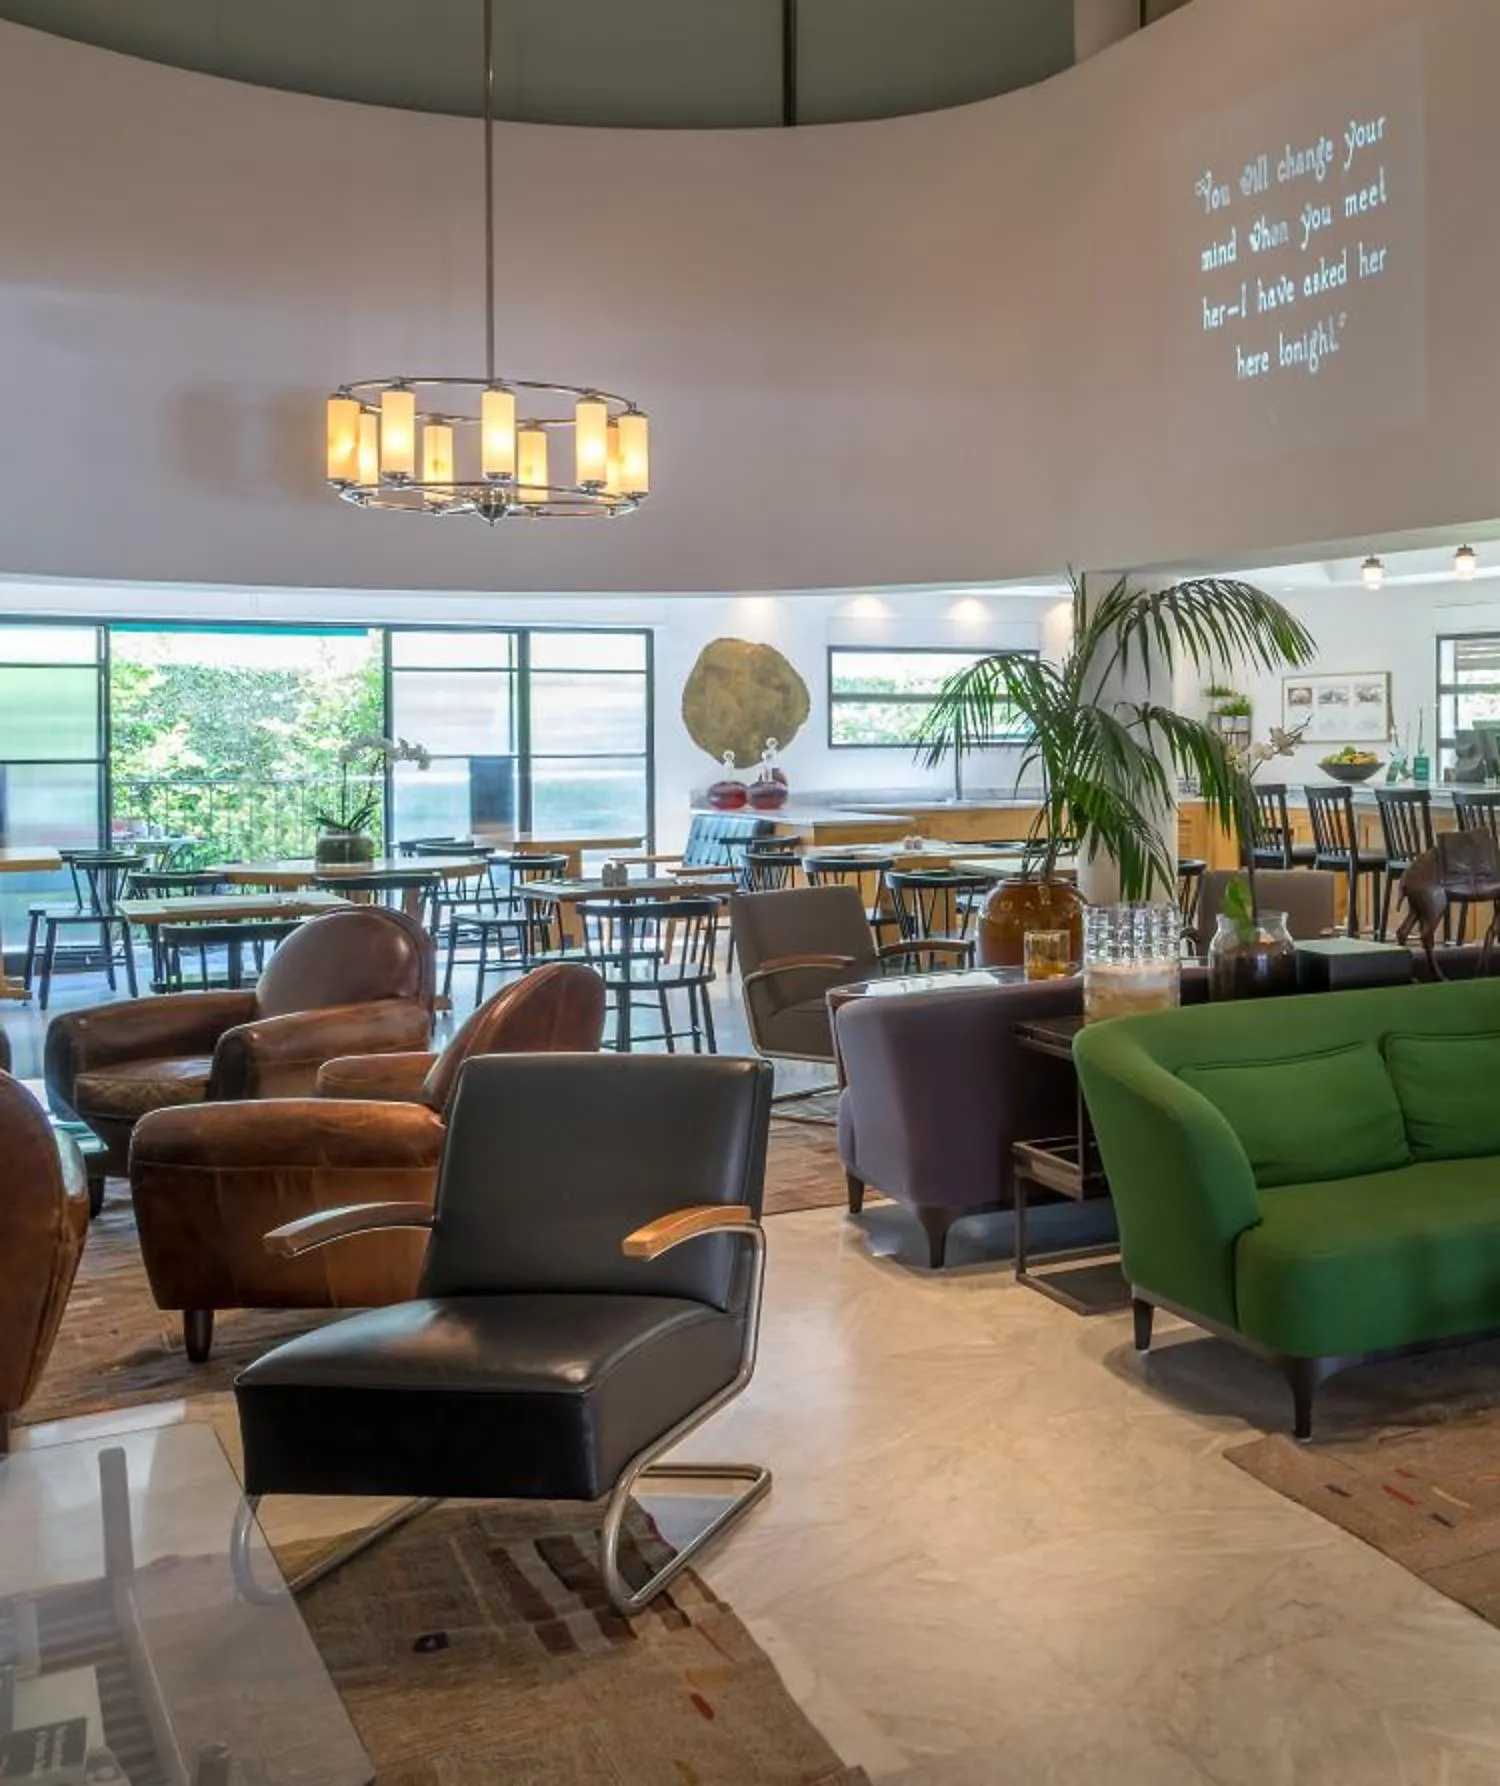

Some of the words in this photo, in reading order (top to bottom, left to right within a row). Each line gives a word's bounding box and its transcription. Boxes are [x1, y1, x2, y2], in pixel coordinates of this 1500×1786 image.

[1278, 138, 1333, 182] change
[1344, 116, 1386, 171] your
[1201, 227, 1237, 271] mind
[1301, 203, 1331, 250] you
[1345, 166, 1386, 218] meet
[1258, 275, 1294, 312] have
[1303, 248, 1347, 296] asked
[1359, 241, 1387, 278] her
[1237, 346, 1269, 379] here
